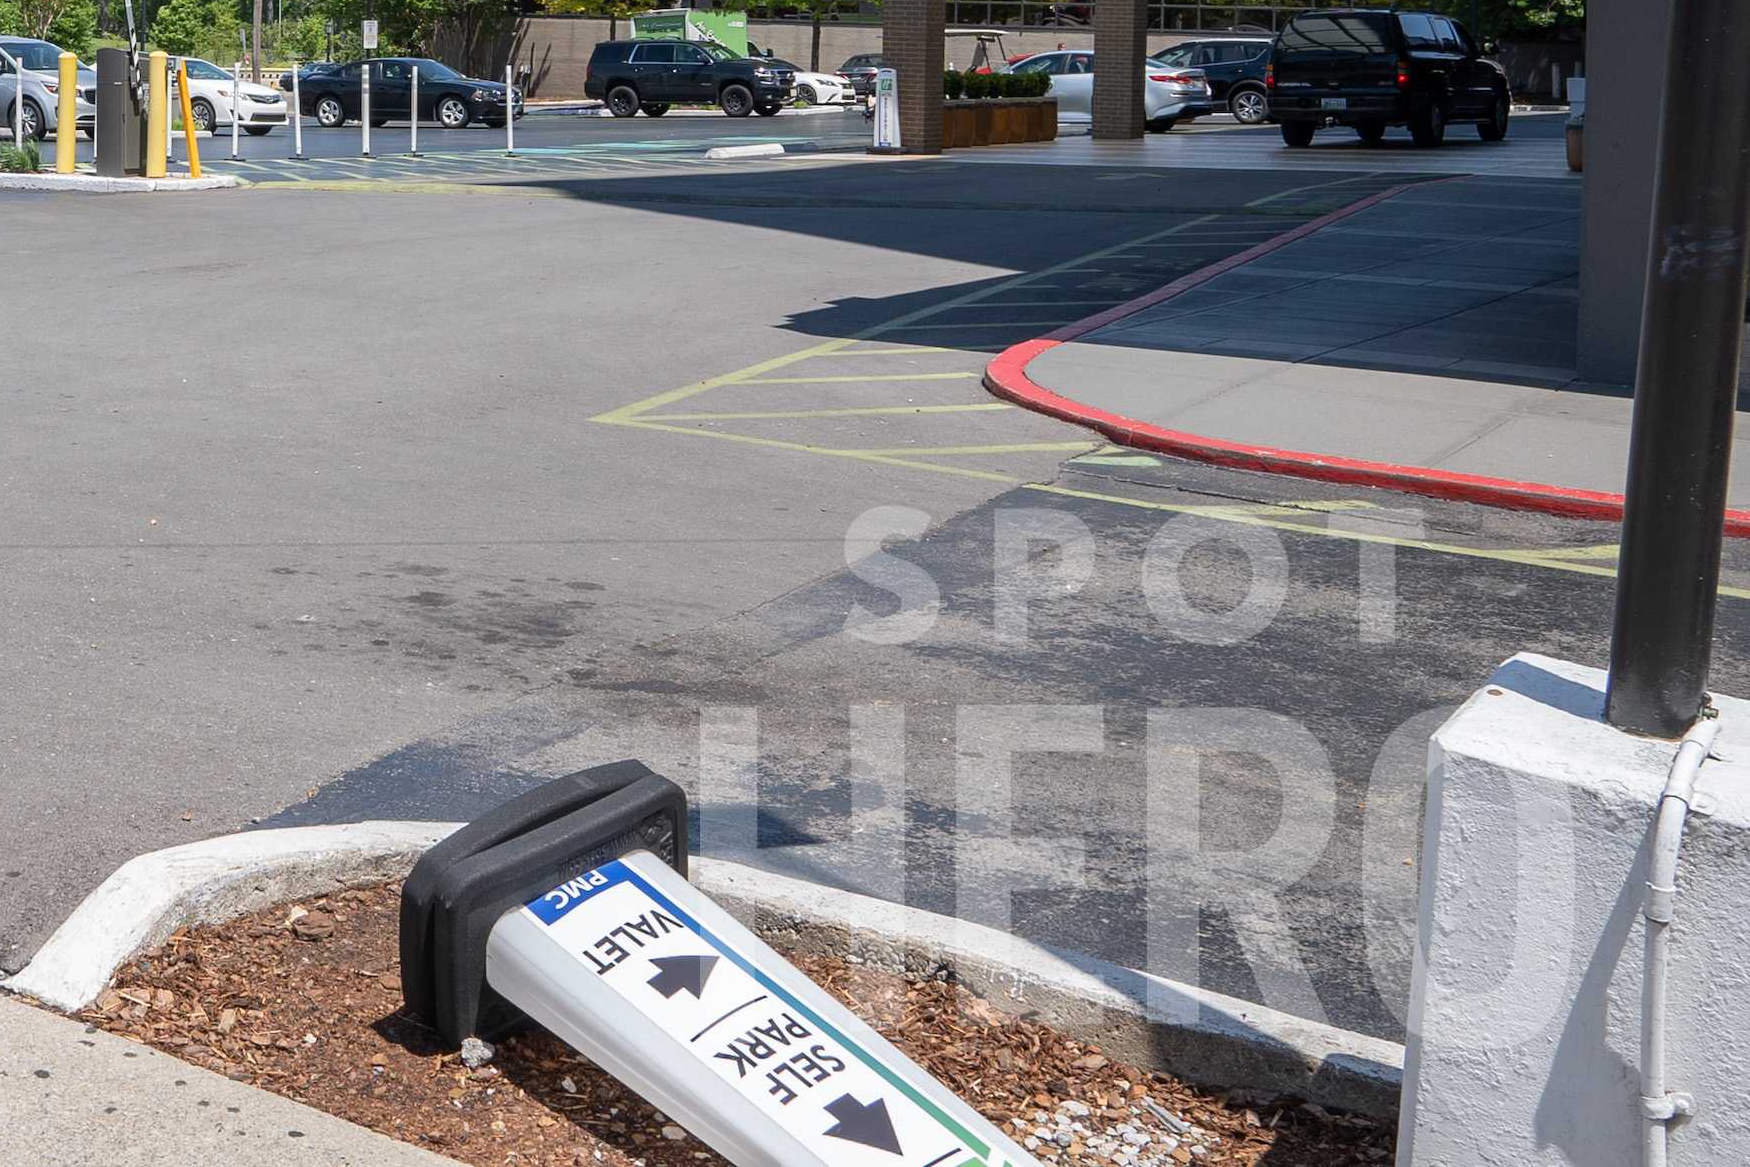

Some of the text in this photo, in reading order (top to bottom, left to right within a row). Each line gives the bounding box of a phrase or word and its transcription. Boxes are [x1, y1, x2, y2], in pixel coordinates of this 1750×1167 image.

[545, 870, 609, 910] PMC
[582, 910, 685, 976] VALET
[713, 1012, 813, 1079] PARK
[765, 1044, 846, 1106] SELF
